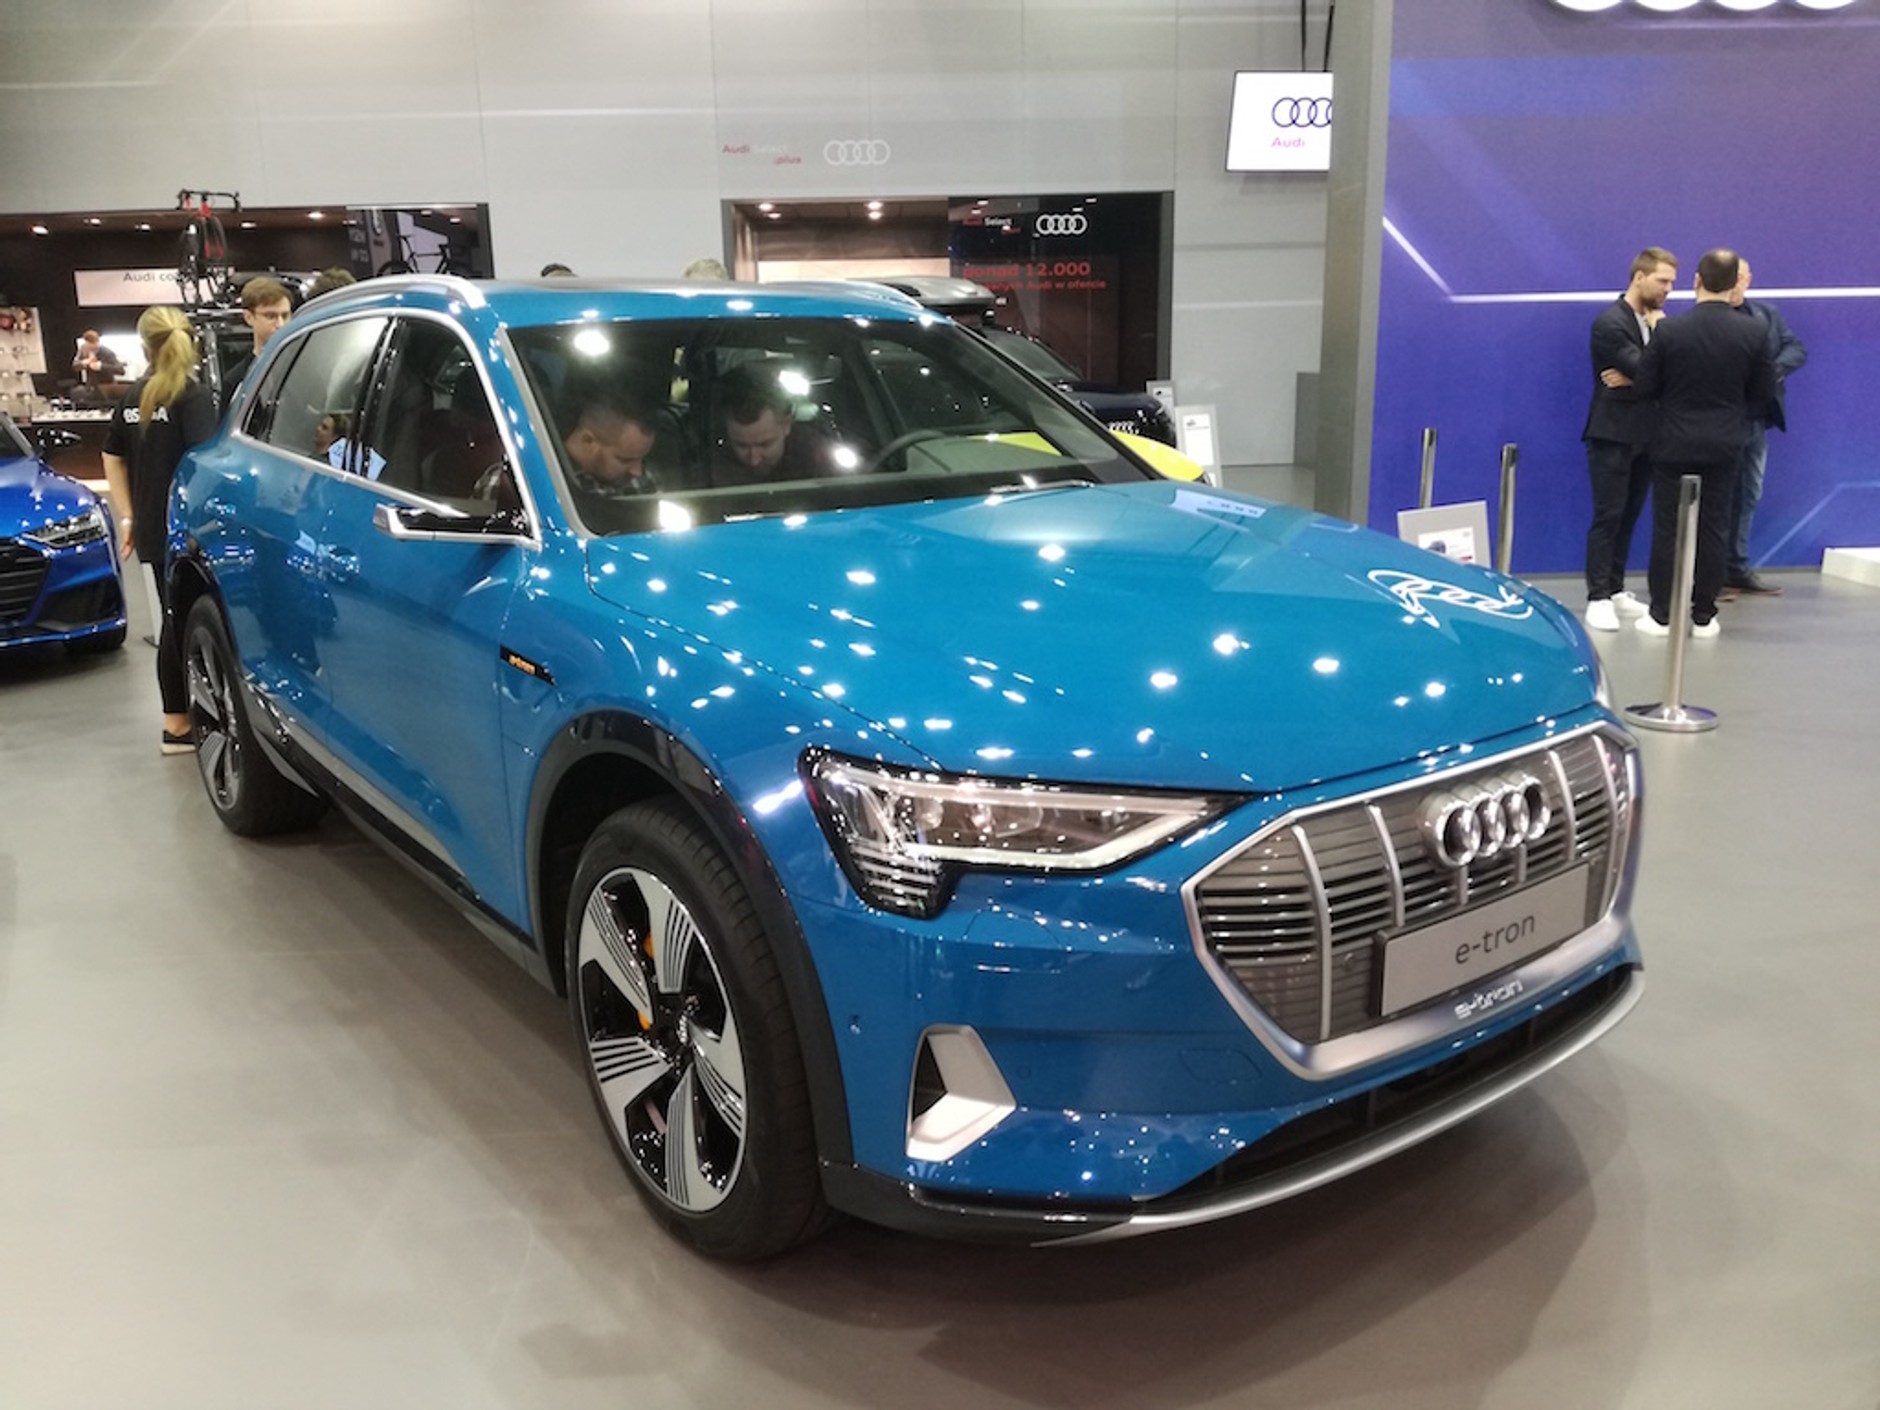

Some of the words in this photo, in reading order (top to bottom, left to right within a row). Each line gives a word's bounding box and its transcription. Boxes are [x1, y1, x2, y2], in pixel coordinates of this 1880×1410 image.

[1271, 136, 1305, 148] Audi
[722, 144, 750, 155] Audi
[985, 217, 1012, 226] Select
[962, 263, 1019, 280] ponad
[1026, 262, 1091, 277] 12.000
[122, 272, 156, 283] Audi
[1455, 915, 1535, 965] e-tron
[1454, 980, 1523, 1020] e-tron
